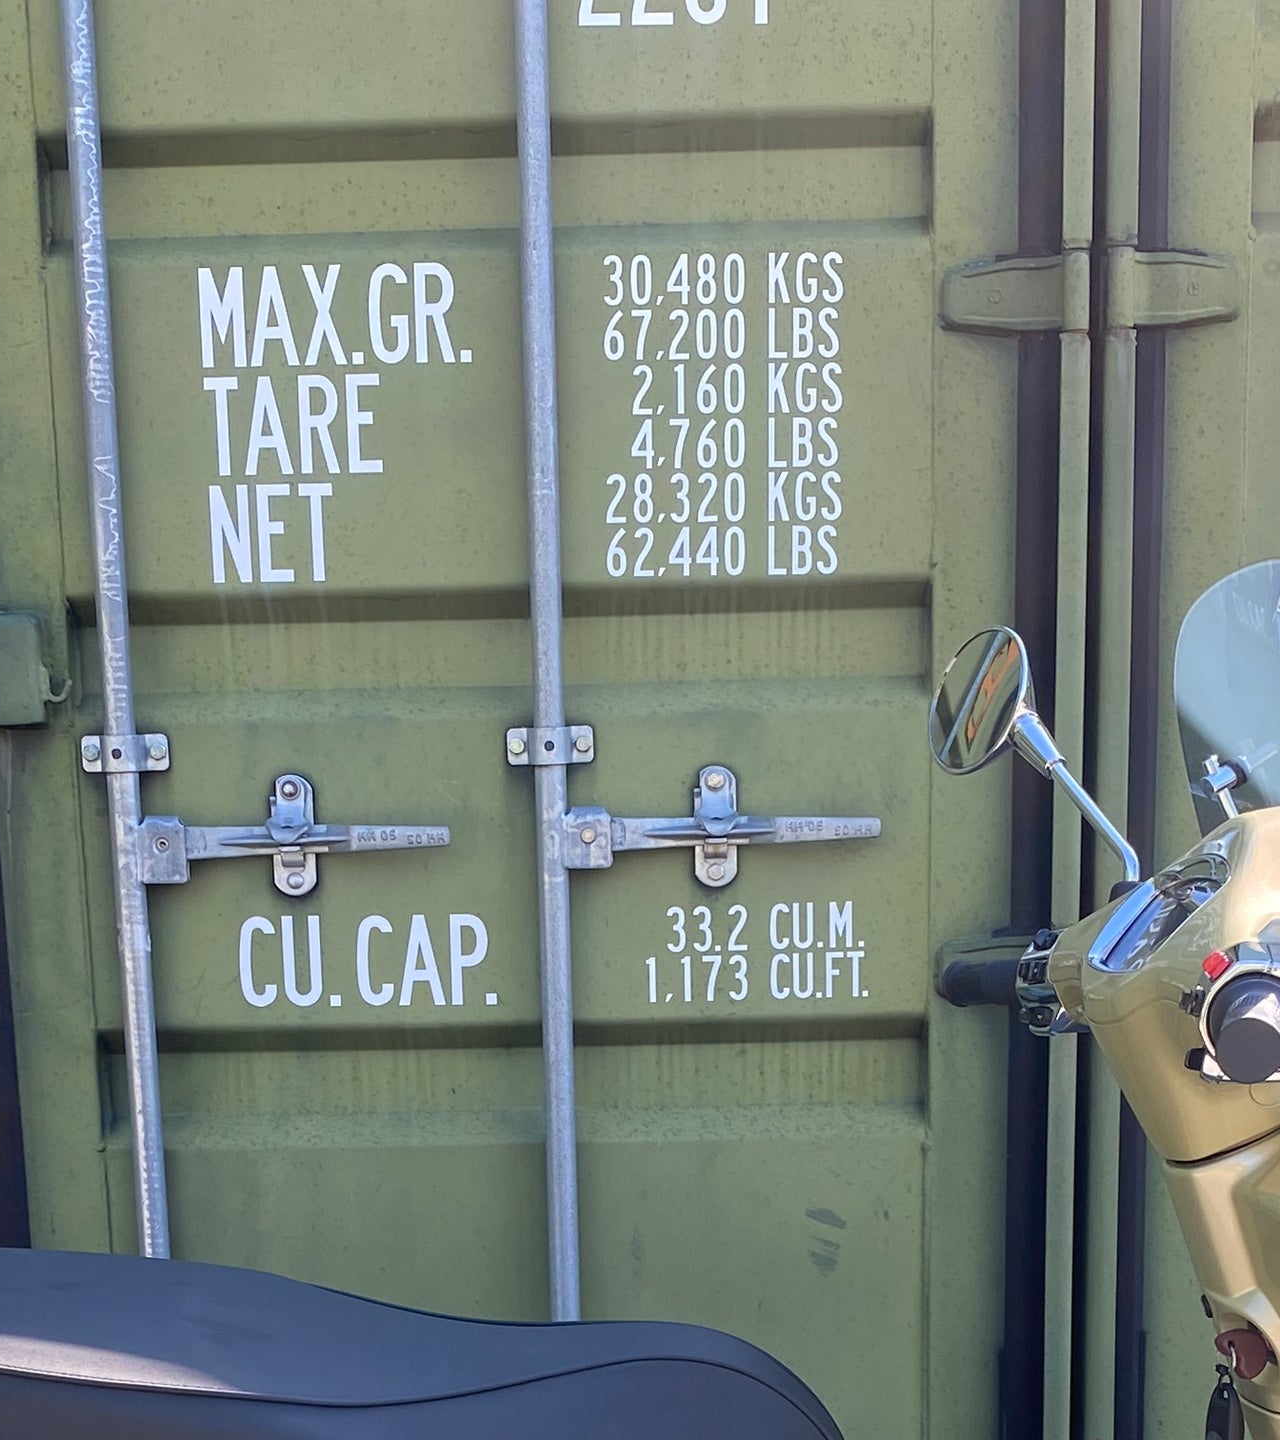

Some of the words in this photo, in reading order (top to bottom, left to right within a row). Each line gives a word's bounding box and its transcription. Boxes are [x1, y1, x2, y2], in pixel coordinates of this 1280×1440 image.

[604, 254, 744, 309] 30,480
[769, 252, 843, 303] KGS
[198, 263, 471, 367] MAX.GR.
[604, 309, 744, 364] 67,200
[769, 307, 839, 358] LBS
[633, 364, 744, 418] 2,160
[769, 362, 842, 413] KGS
[204, 374, 383, 475] TARE
[632, 418, 745, 470] 4,760
[769, 417, 838, 467] LBS
[607, 473, 745, 526] 28,320
[769, 471, 841, 521] KGS
[209, 483, 332, 583] NET
[607, 526, 745, 580] 62,440
[768, 525, 837, 575] LBS
[667, 905, 747, 952] 33.2
[770, 901, 864, 949] CU.M.
[646, 955, 747, 1003] 1,173
[771, 951, 868, 999] CU.FT.
